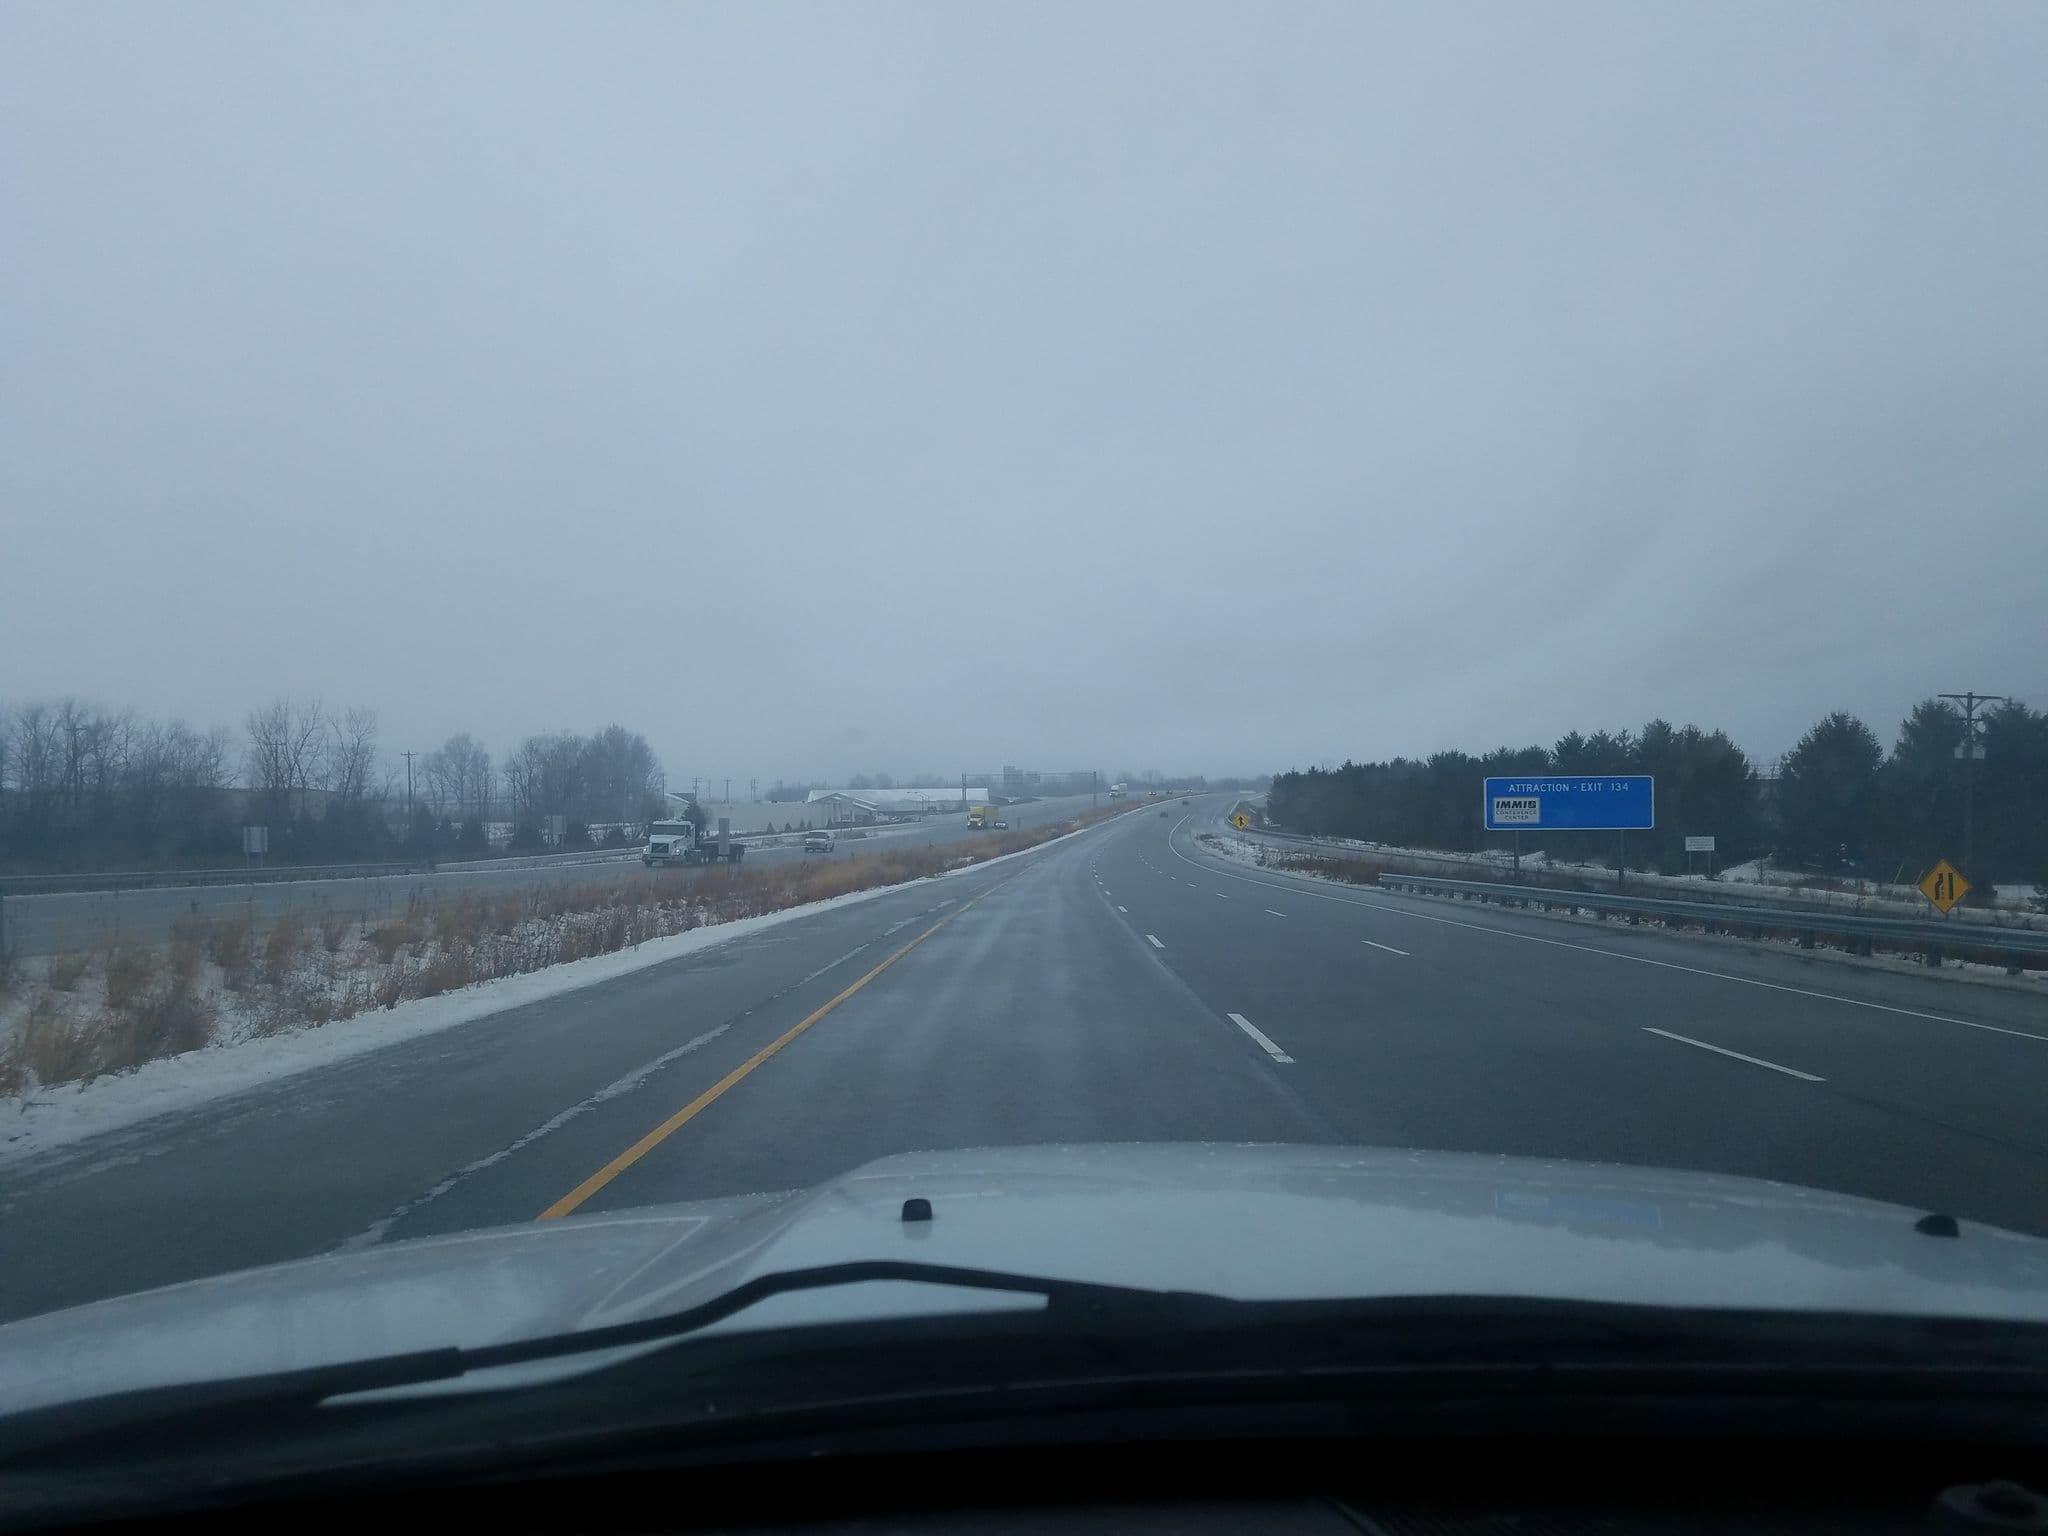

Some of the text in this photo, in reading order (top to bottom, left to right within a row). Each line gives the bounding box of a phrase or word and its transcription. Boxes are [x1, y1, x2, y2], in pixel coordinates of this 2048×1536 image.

[1508, 784, 1569, 792] ATTRACTION
[1581, 783, 1602, 791] EXIT
[1611, 783, 1629, 791] 134
